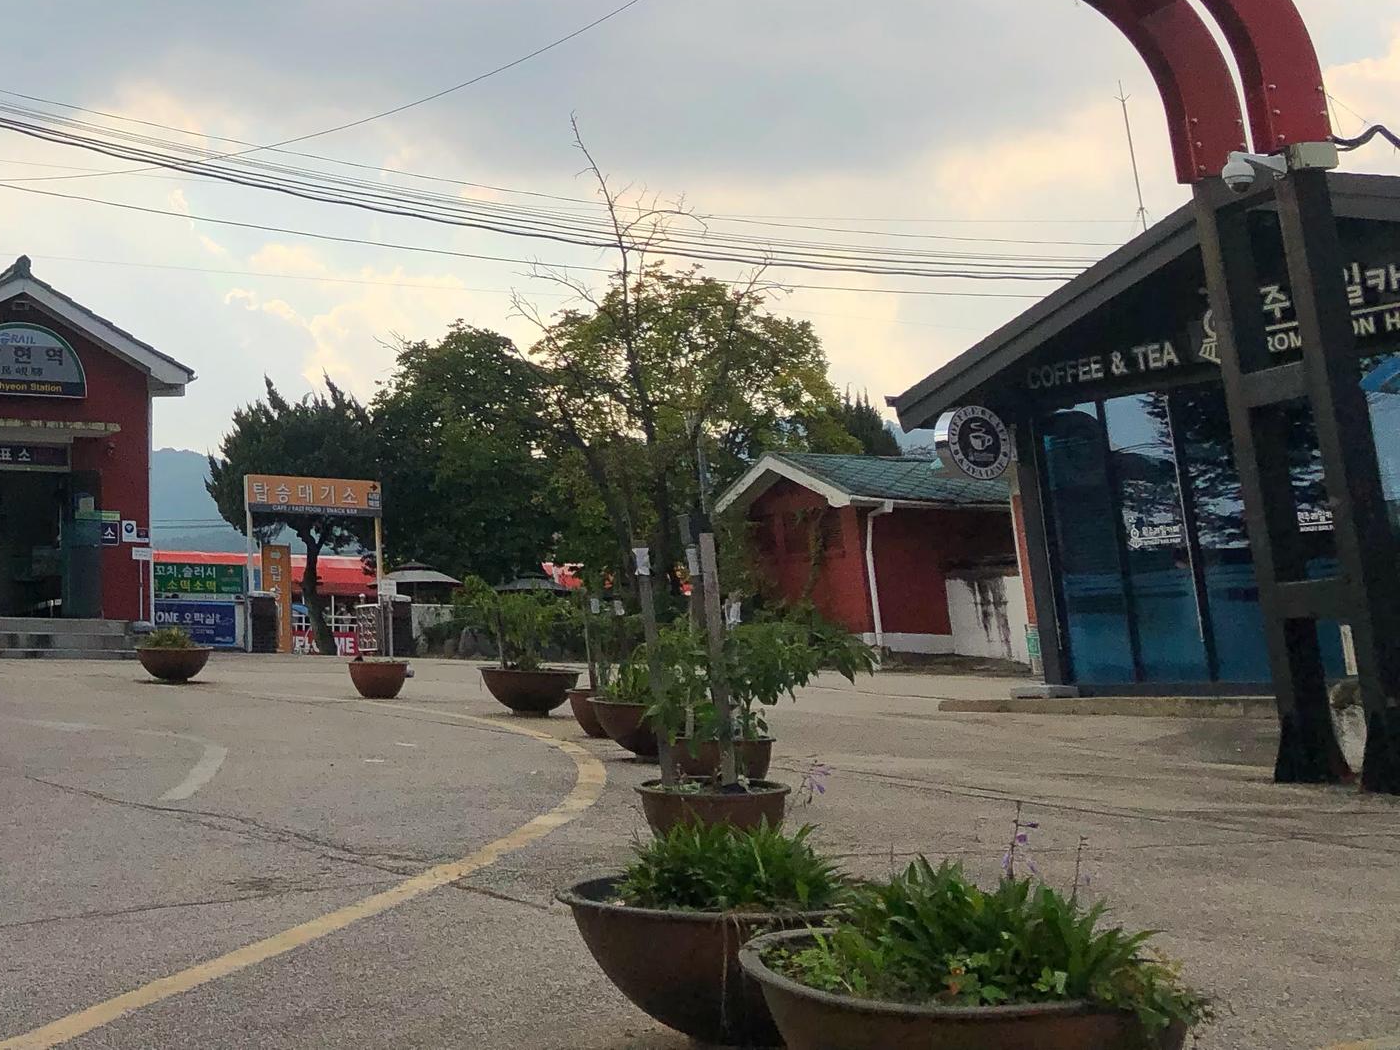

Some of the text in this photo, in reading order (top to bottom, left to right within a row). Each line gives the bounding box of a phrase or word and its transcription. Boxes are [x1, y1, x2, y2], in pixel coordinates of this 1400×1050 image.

[1026, 341, 1180, 389] COFFEE & TEA
[30, 382, 62, 393] Station
